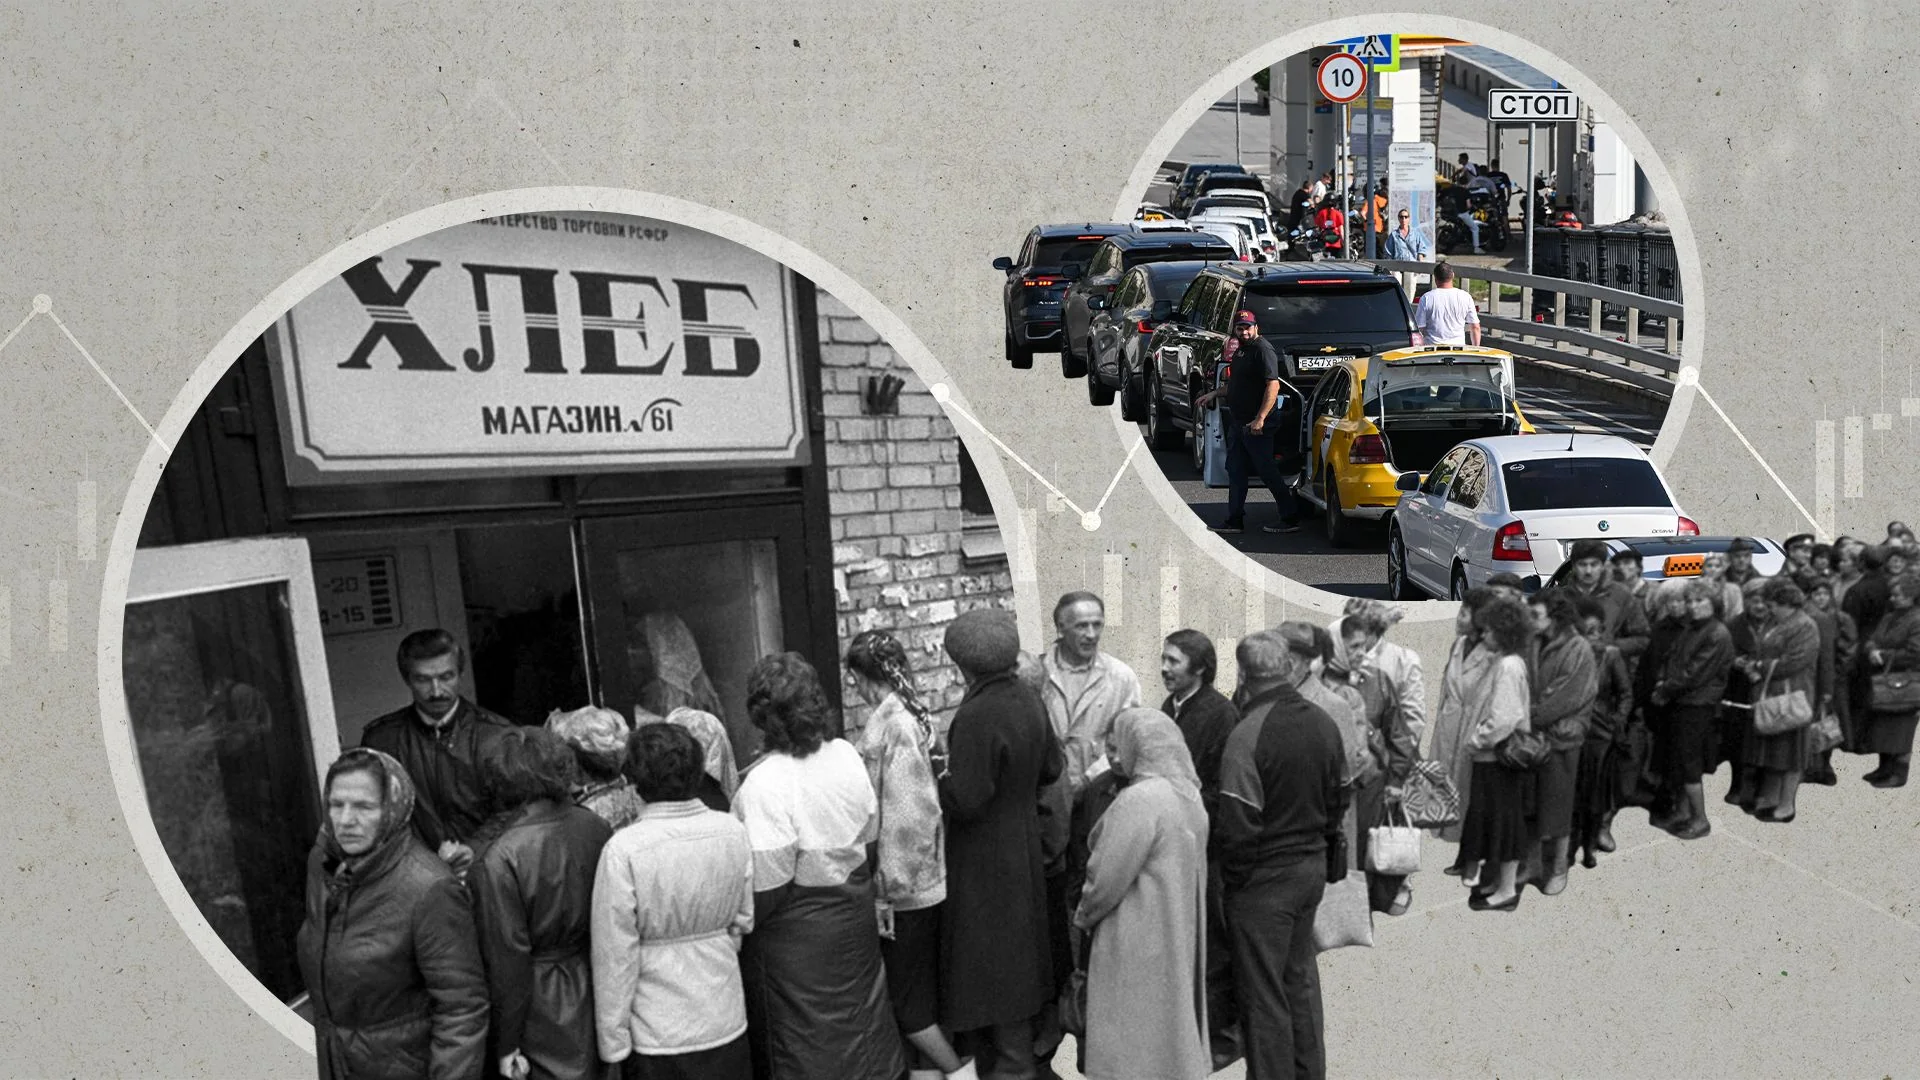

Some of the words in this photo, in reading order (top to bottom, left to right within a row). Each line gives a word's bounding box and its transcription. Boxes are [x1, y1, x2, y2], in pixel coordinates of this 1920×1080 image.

[1332, 68, 1354, 87] 10
[1500, 95, 1569, 115] СТОП
[475, 214, 558, 231] ИСТЕРСТВО
[563, 218, 626, 237] ТОРГОВЛИ
[628, 225, 669, 242] РСФСР
[337, 256, 762, 377] ХЛЕБ
[481, 405, 622, 435] МАГАЗИН
